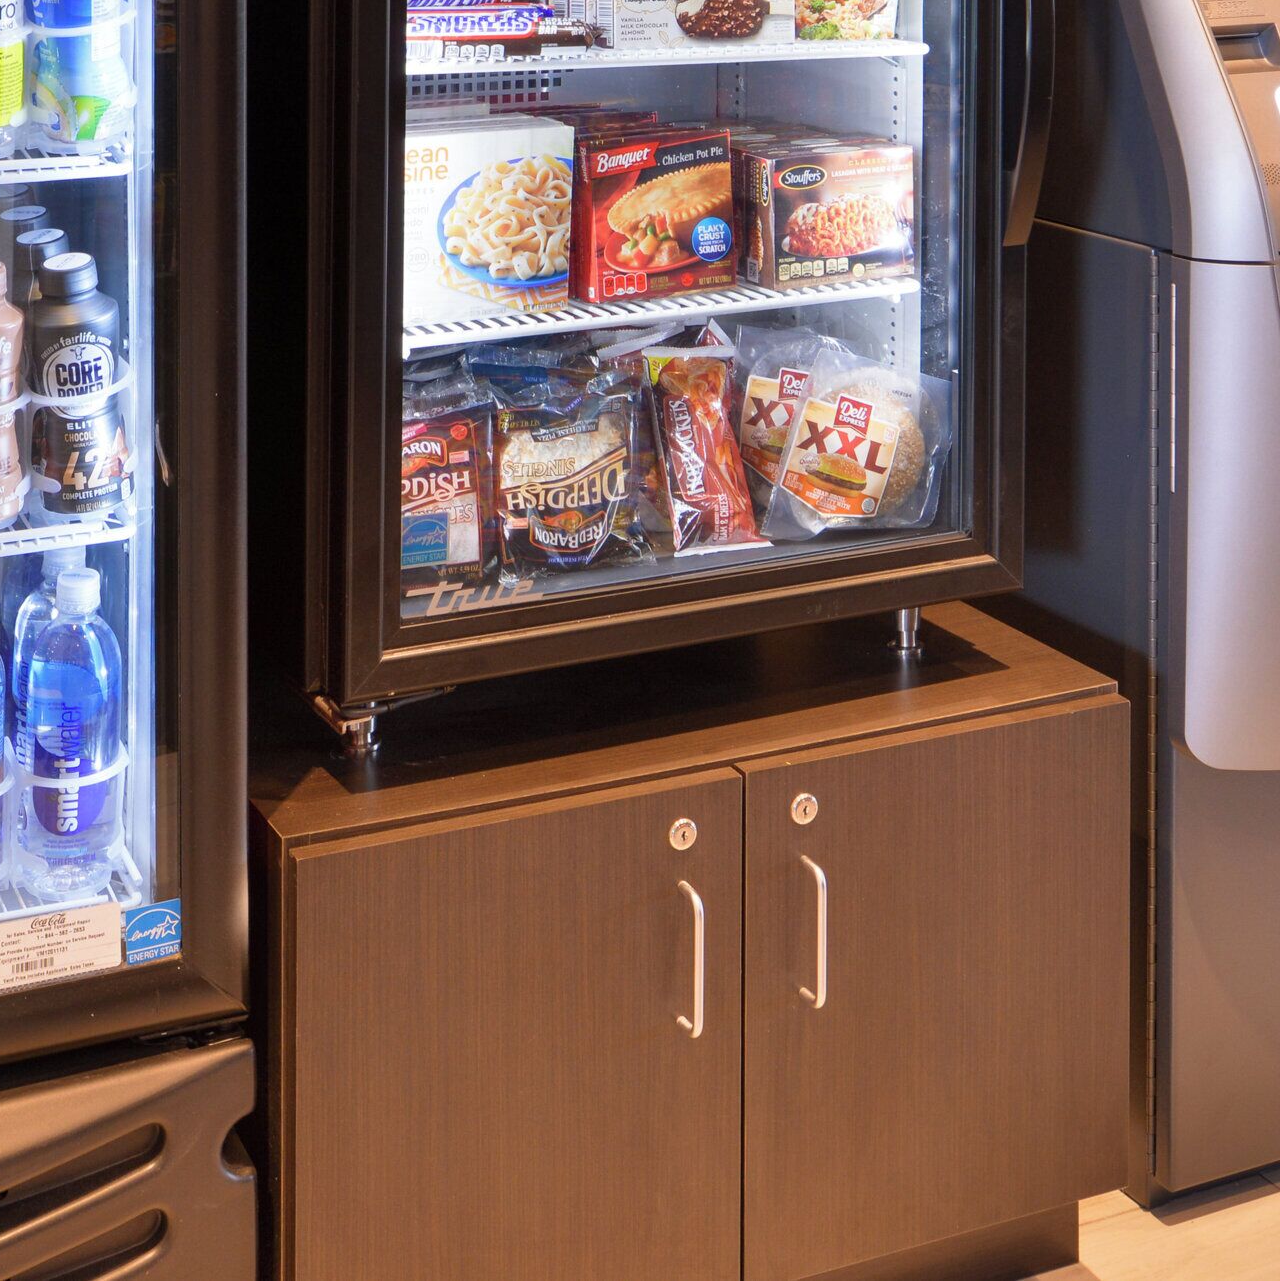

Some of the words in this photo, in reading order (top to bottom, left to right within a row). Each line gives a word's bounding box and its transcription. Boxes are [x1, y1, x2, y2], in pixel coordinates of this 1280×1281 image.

[409, 16, 531, 34] SNICKERS
[596, 146, 651, 173] Banquet
[661, 152, 695, 166] Chicken
[696, 148, 709, 159] Pot
[709, 146, 724, 157] Pie
[784, 168, 822, 186] Stouffer's
[697, 223, 725, 234] FLAKY
[698, 231, 726, 241] CRUST
[698, 243, 726, 255] SCRATCH
[55, 356, 104, 387] CORE
[57, 382, 105, 398] POWER
[839, 401, 868, 421] Deli
[838, 414, 866, 428] EXPRESS
[796, 419, 888, 475] XXL
[502, 457, 576, 478] SINGLES
[62, 489, 94, 501] COMPLETE
[93, 483, 118, 497] PROTEIN
[402, 553, 429, 565] ENERGY
[428, 551, 448, 562] STAR
[405, 579, 545, 618] true
[30, 912, 67, 930] Coca-Cola
[129, 947, 160, 964] ENERGY
[159, 943, 180, 958] STAR
